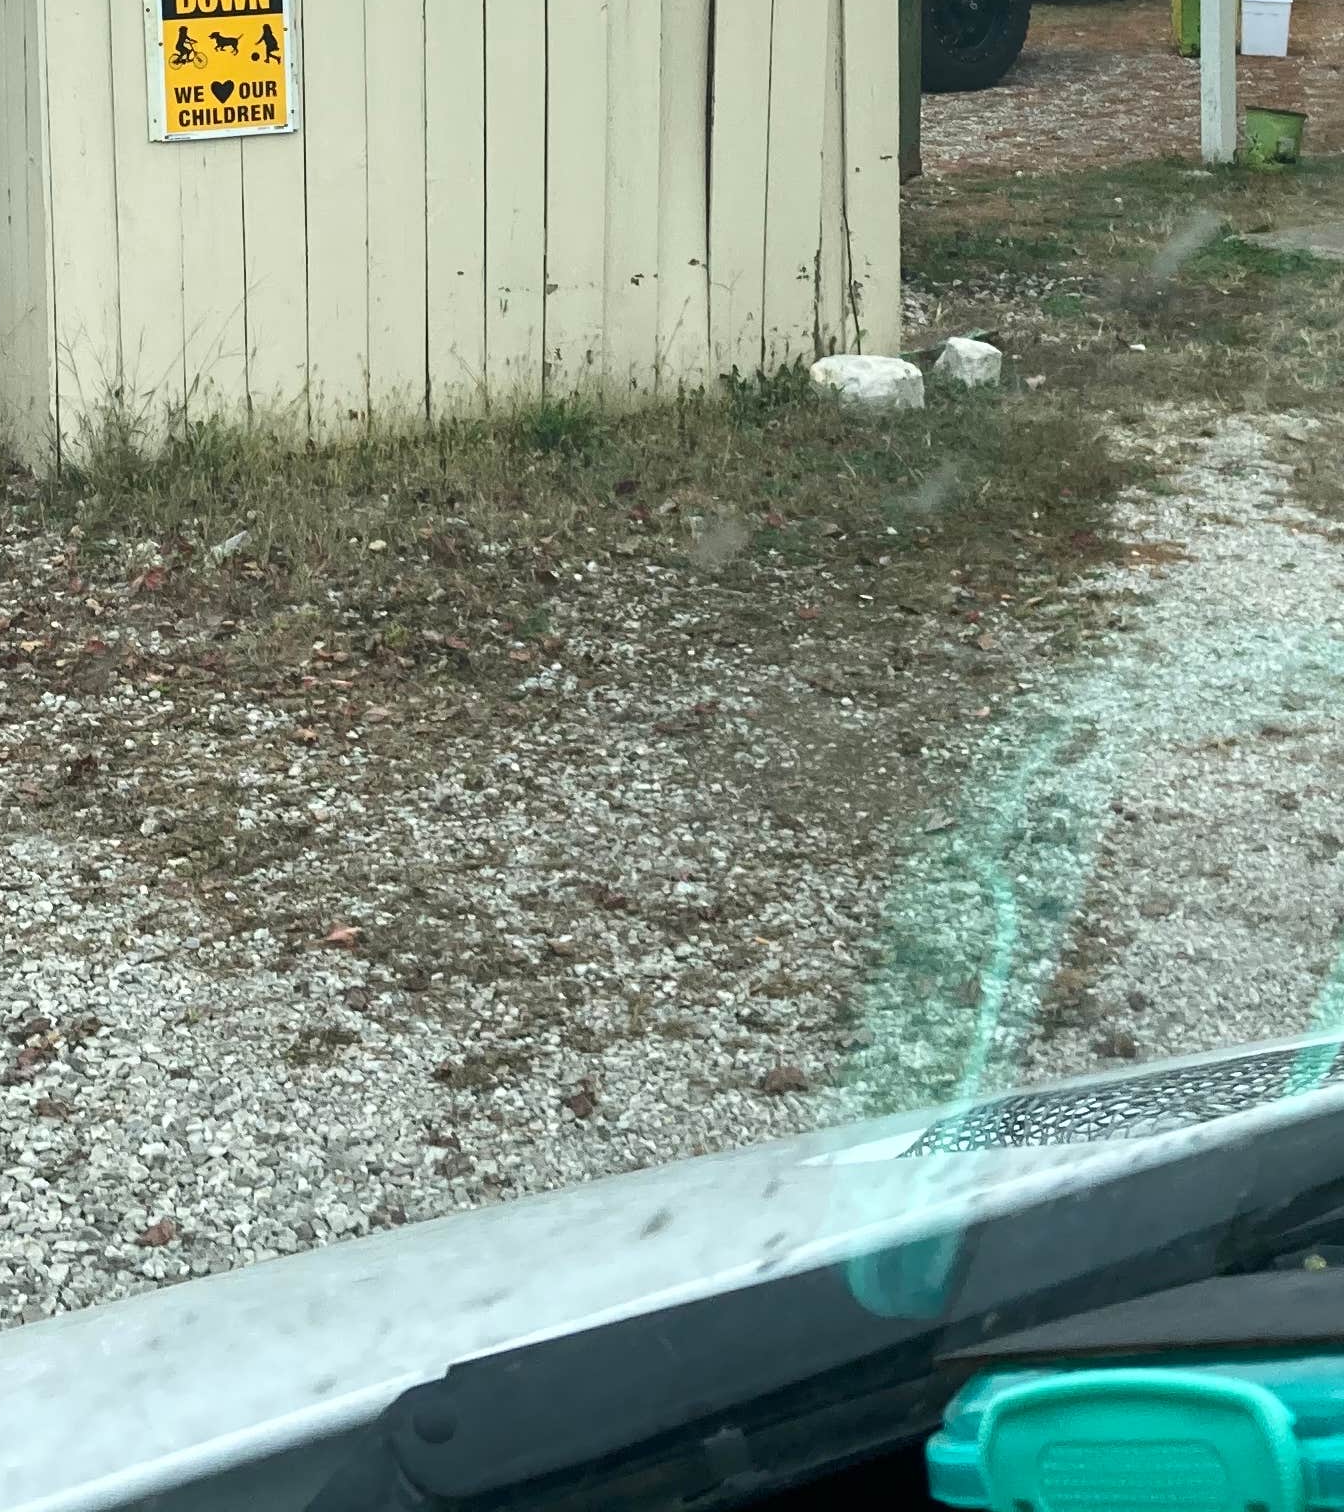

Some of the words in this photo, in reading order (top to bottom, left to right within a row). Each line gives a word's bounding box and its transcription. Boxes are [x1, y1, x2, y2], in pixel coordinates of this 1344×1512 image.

[174, 85, 205, 104] WE
[239, 80, 278, 100] OUR
[178, 103, 276, 128] CHILDREN
